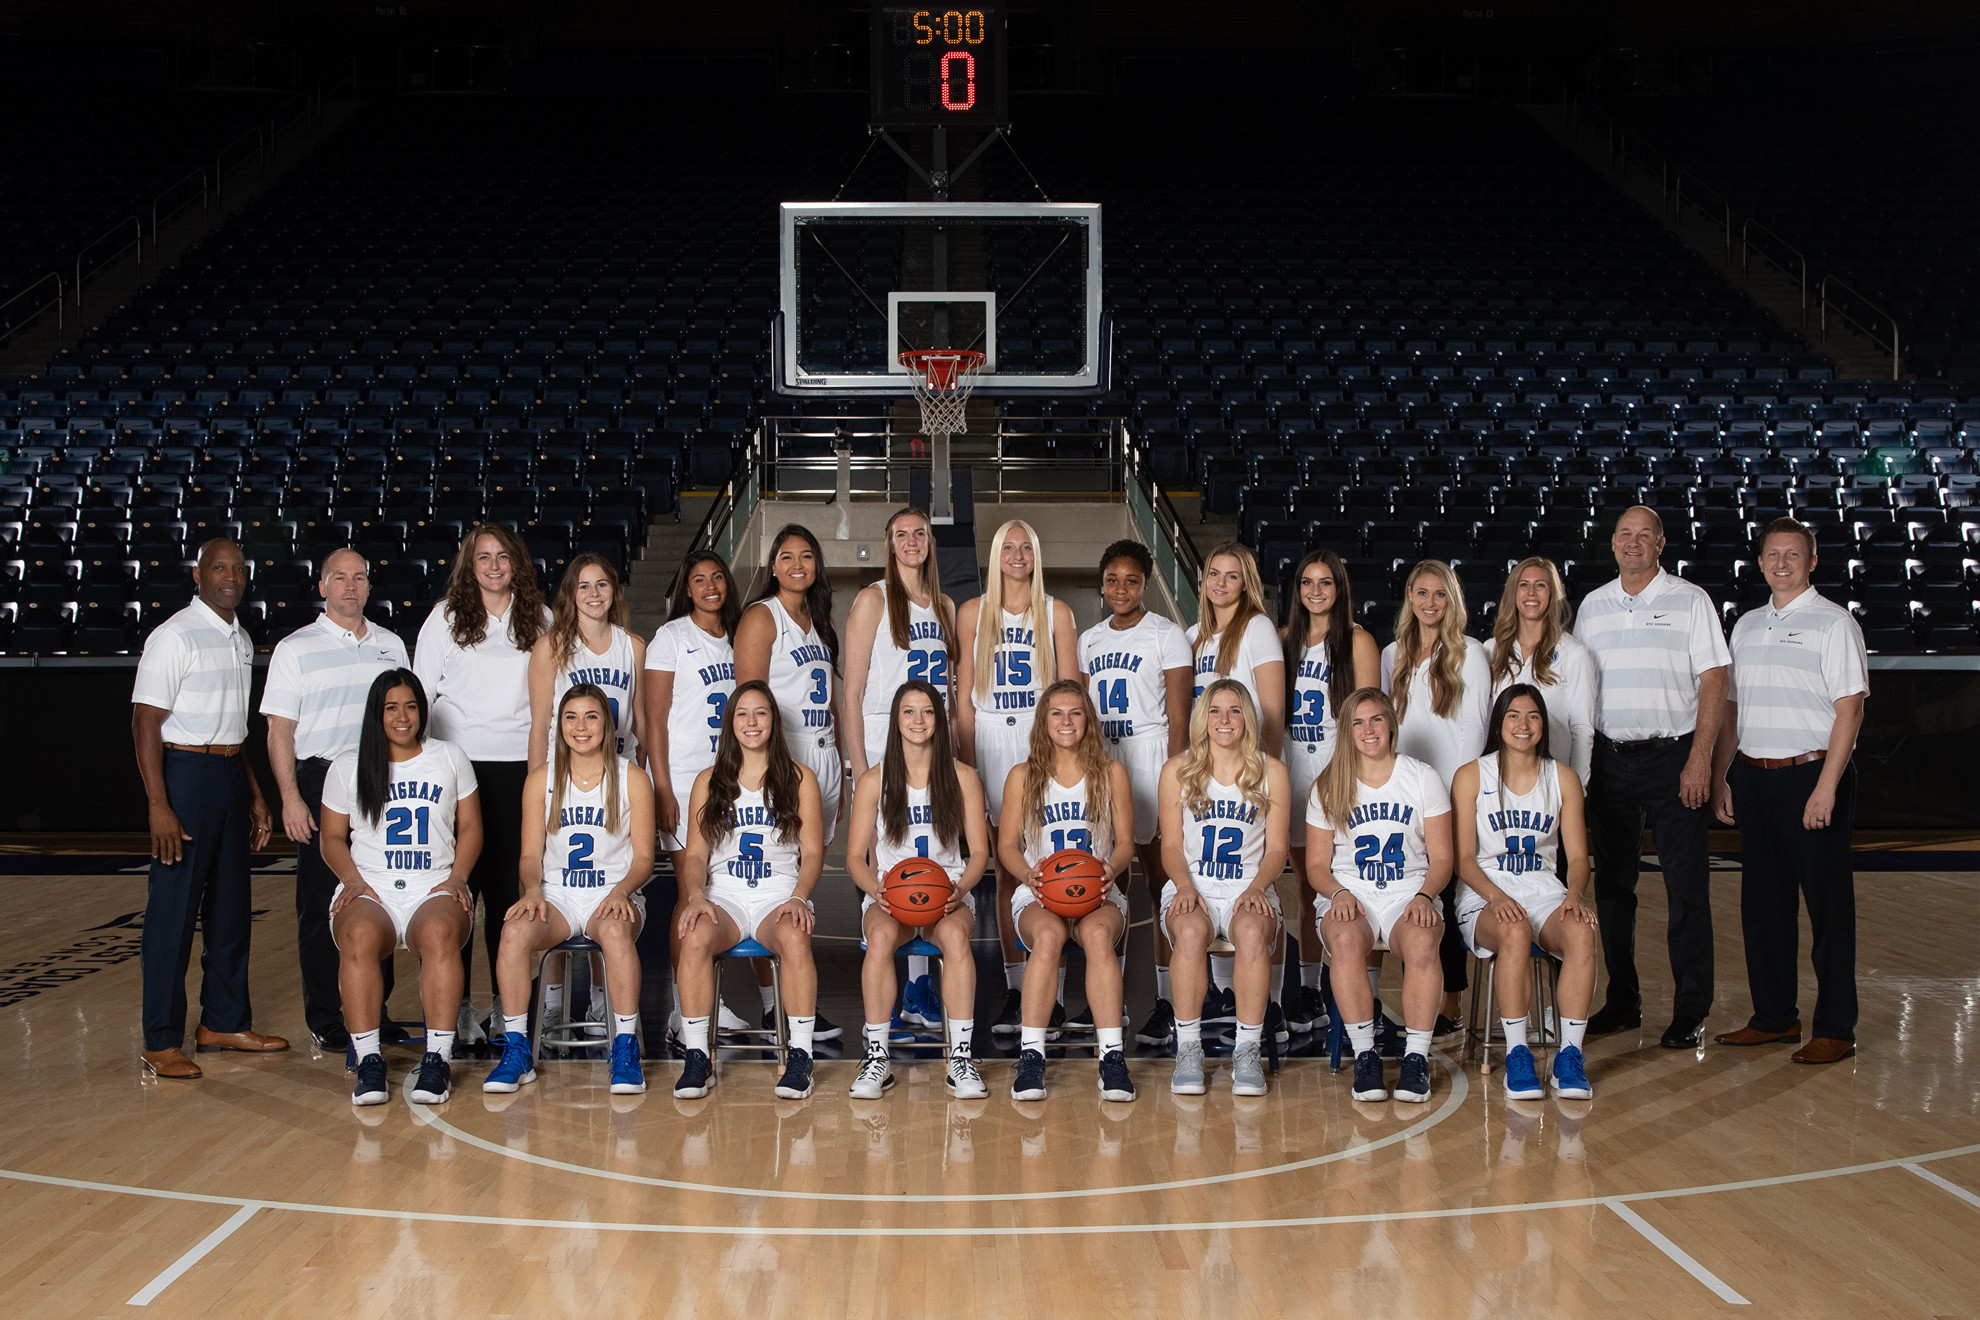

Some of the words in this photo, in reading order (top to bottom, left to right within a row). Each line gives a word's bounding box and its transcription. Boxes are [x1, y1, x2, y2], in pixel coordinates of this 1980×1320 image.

[913, 11, 985, 45] 5:00
[941, 51, 975, 111] 0
[795, 378, 827, 386] SPALDING
[909, 622, 947, 643] RIGHA
[996, 627, 1036, 648] IGHA
[698, 662, 735, 686] BRIGH
[907, 649, 948, 686] 22
[994, 651, 1032, 686] 15
[1088, 652, 1143, 677] BRIGHAM
[568, 668, 630, 691] BRIGHAM
[810, 668, 828, 704] 3
[993, 690, 1036, 710] YOUNG
[1098, 678, 1129, 715] 14
[1293, 690, 1325, 726] 23
[802, 709, 831, 728] YOUN
[384, 781, 443, 804] IGHAM
[385, 806, 430, 845] 21
[559, 806, 607, 829] RIGHA
[721, 806, 782, 829] IGHA
[1348, 802, 1414, 830] BRIGHAM
[568, 832, 594, 870] 2
[738, 832, 764, 861] 5
[914, 835, 929, 859] 1
[1202, 824, 1244, 864] 12
[1354, 832, 1406, 868] 24
[1505, 835, 1536, 855] 11
[385, 850, 432, 870] YOUNG
[727, 860, 772, 880] YOUNG
[1198, 860, 1244, 879] YOUNG
[1358, 862, 1404, 881] YOUNG
[1496, 853, 1542, 872] YOUNG
[562, 868, 605, 888] YOUNG
